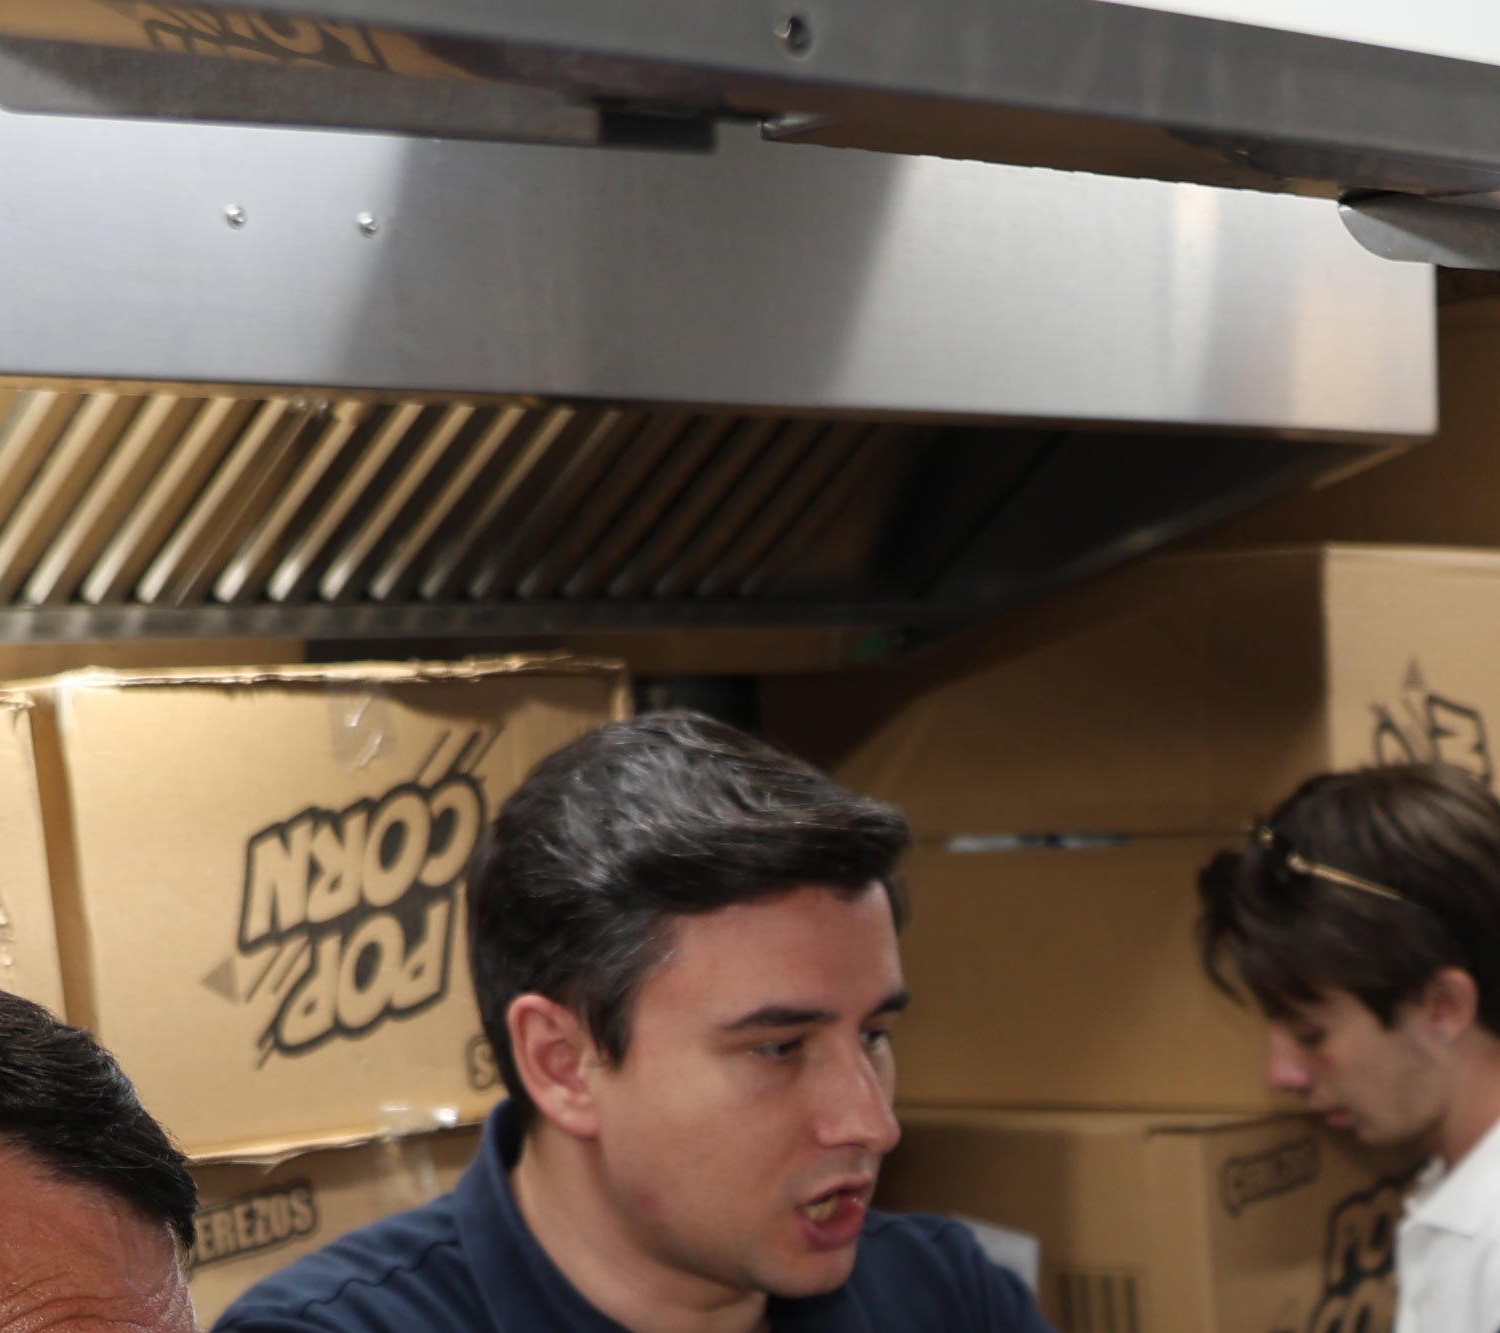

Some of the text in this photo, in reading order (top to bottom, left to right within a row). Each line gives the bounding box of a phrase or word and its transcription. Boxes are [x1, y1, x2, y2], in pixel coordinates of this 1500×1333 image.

[243, 775, 485, 947] CORN
[273, 896, 460, 1050] POP
[194, 1184, 316, 1260] EREZOS
